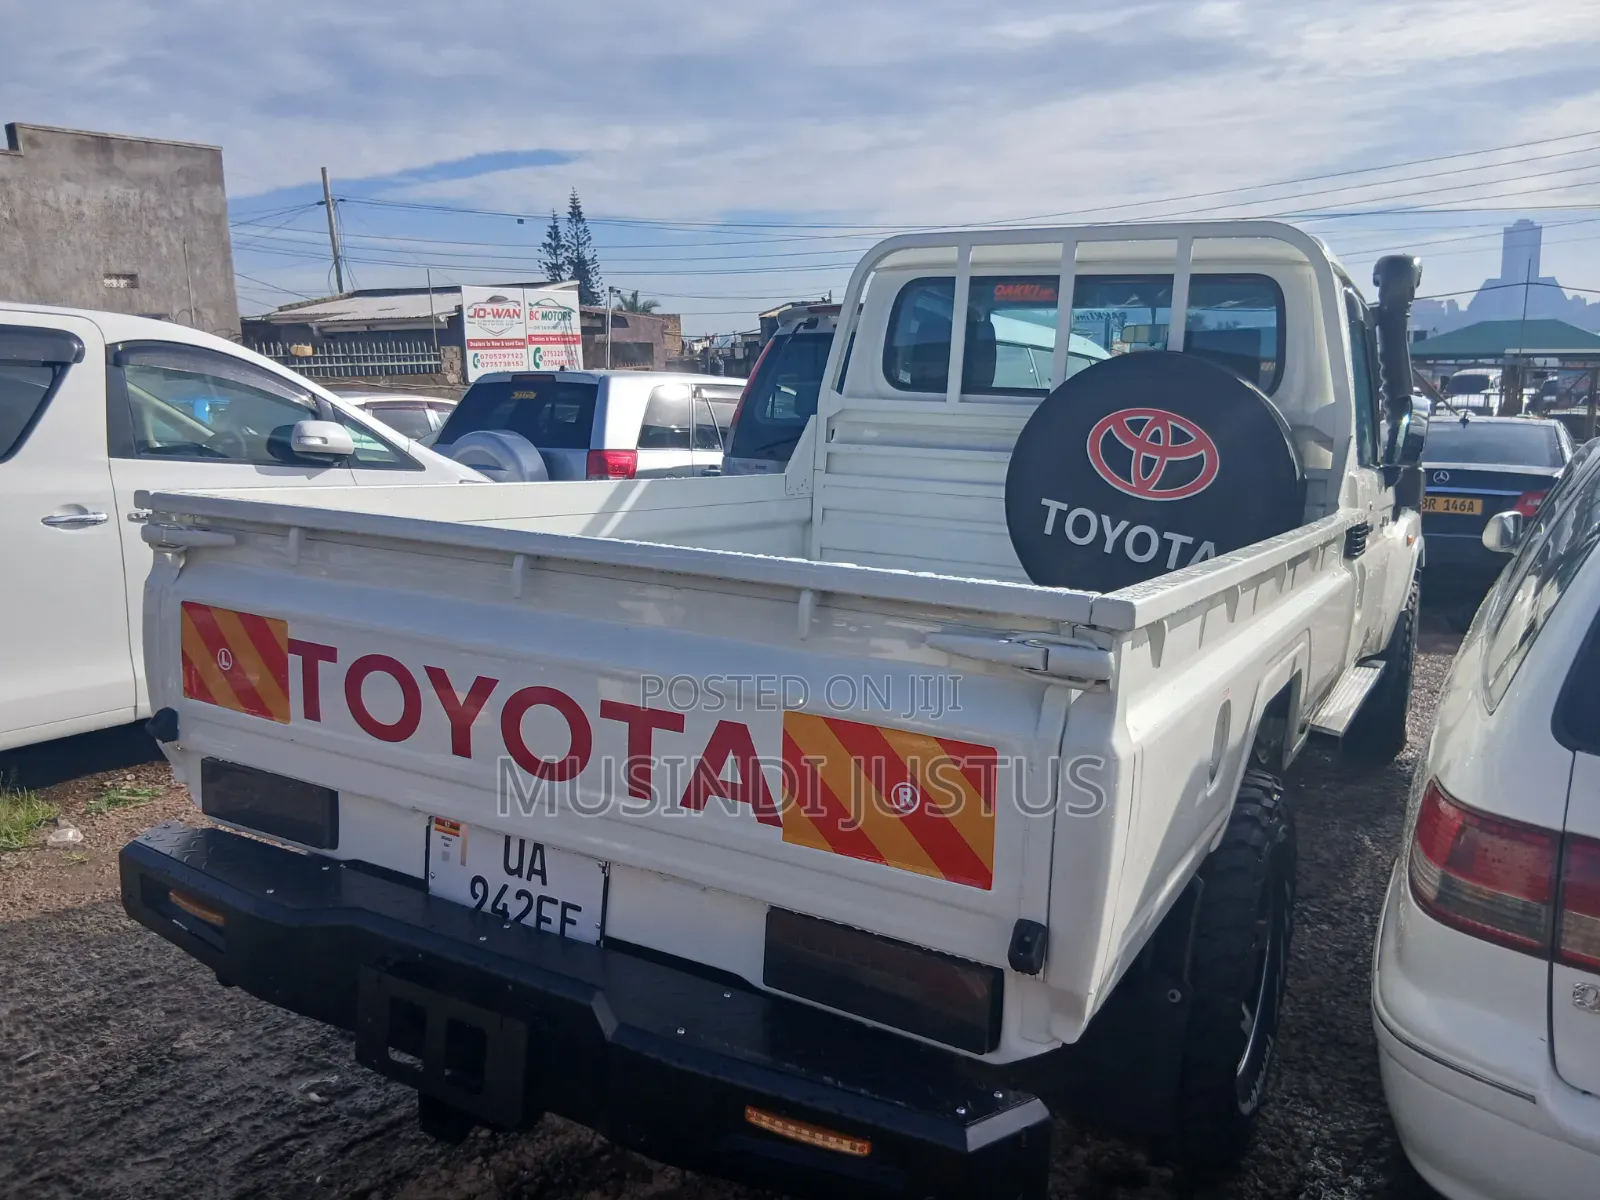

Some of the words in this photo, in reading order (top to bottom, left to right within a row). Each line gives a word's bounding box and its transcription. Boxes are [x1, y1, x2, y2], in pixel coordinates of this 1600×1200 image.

[468, 307, 522, 319] JO-WAN
[529, 310, 539, 321] BC
[541, 310, 572, 321] MOTORS
[1443, 498, 1475, 513] 146A
[288, 637, 783, 828] TOYOTA
[502, 835, 548, 886] UA
